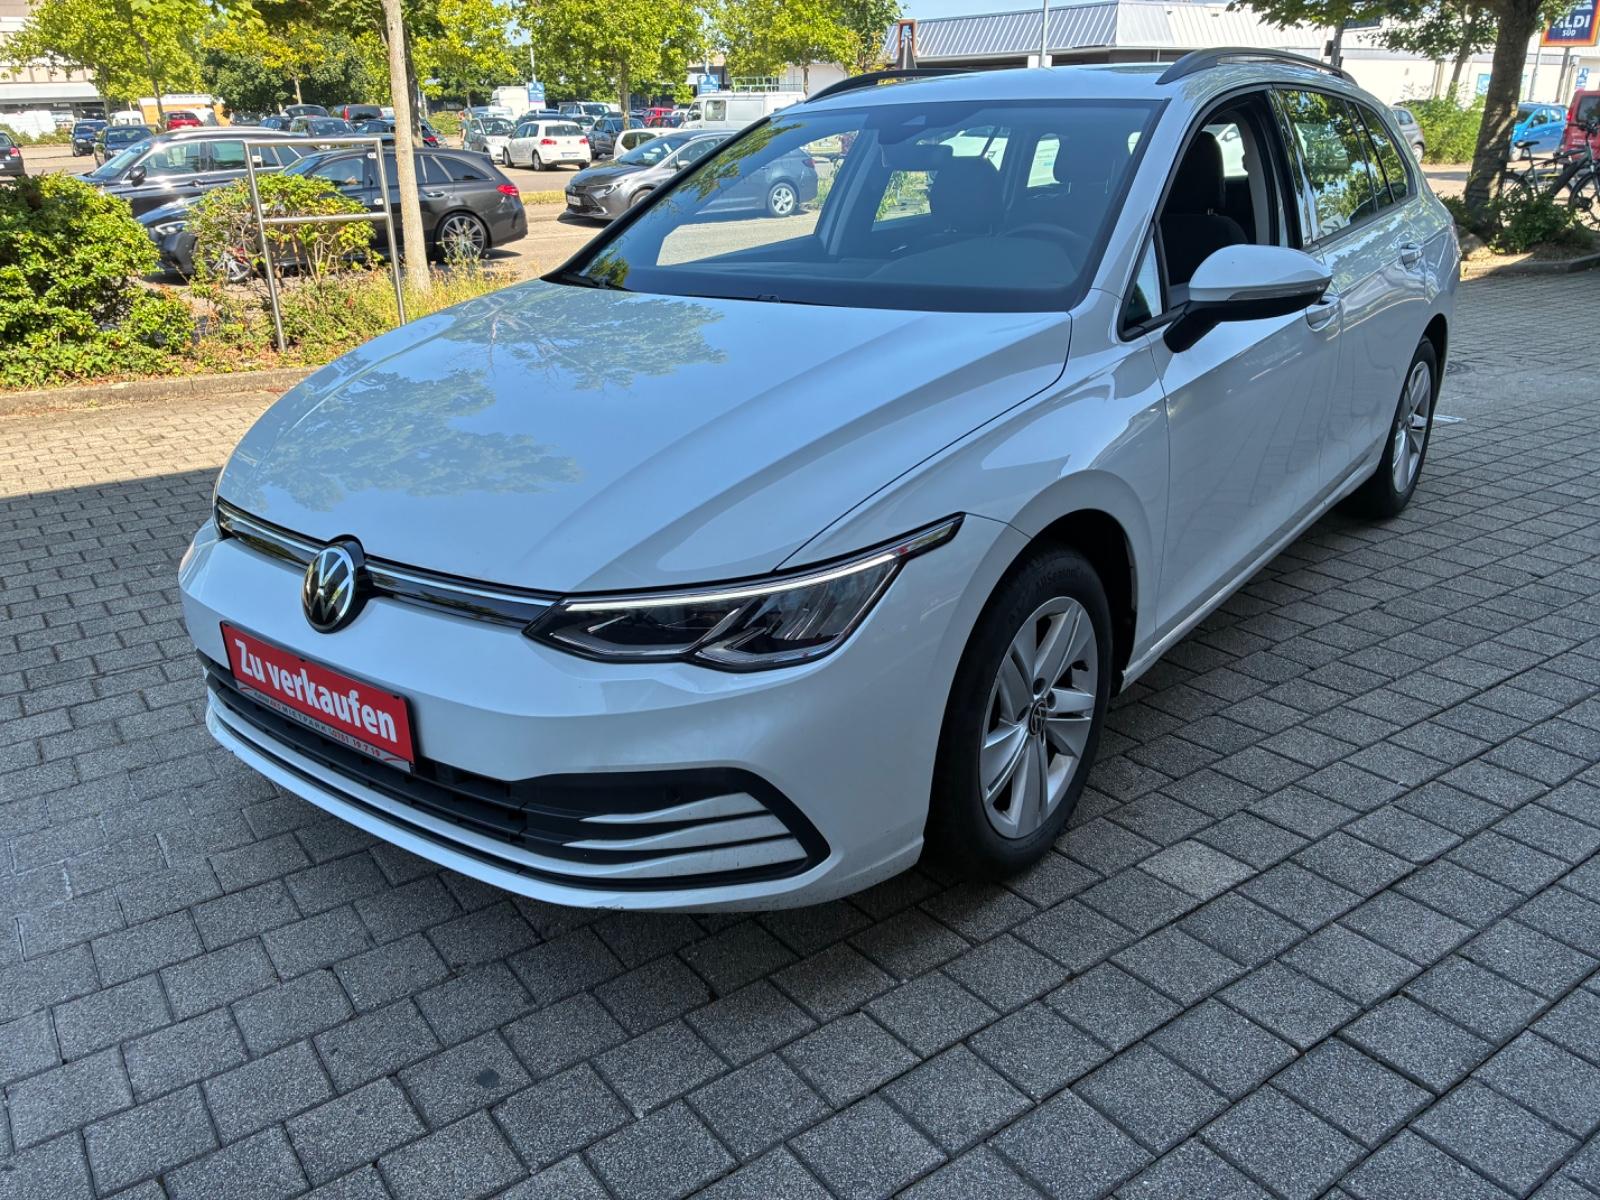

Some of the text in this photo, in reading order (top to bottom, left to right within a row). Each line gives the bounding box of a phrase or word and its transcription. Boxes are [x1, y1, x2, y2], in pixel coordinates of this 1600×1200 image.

[1552, 14, 1591, 28] ALDI
[1562, 28, 1576, 37] SÜD
[234, 638, 398, 743] Zu verkaufen
